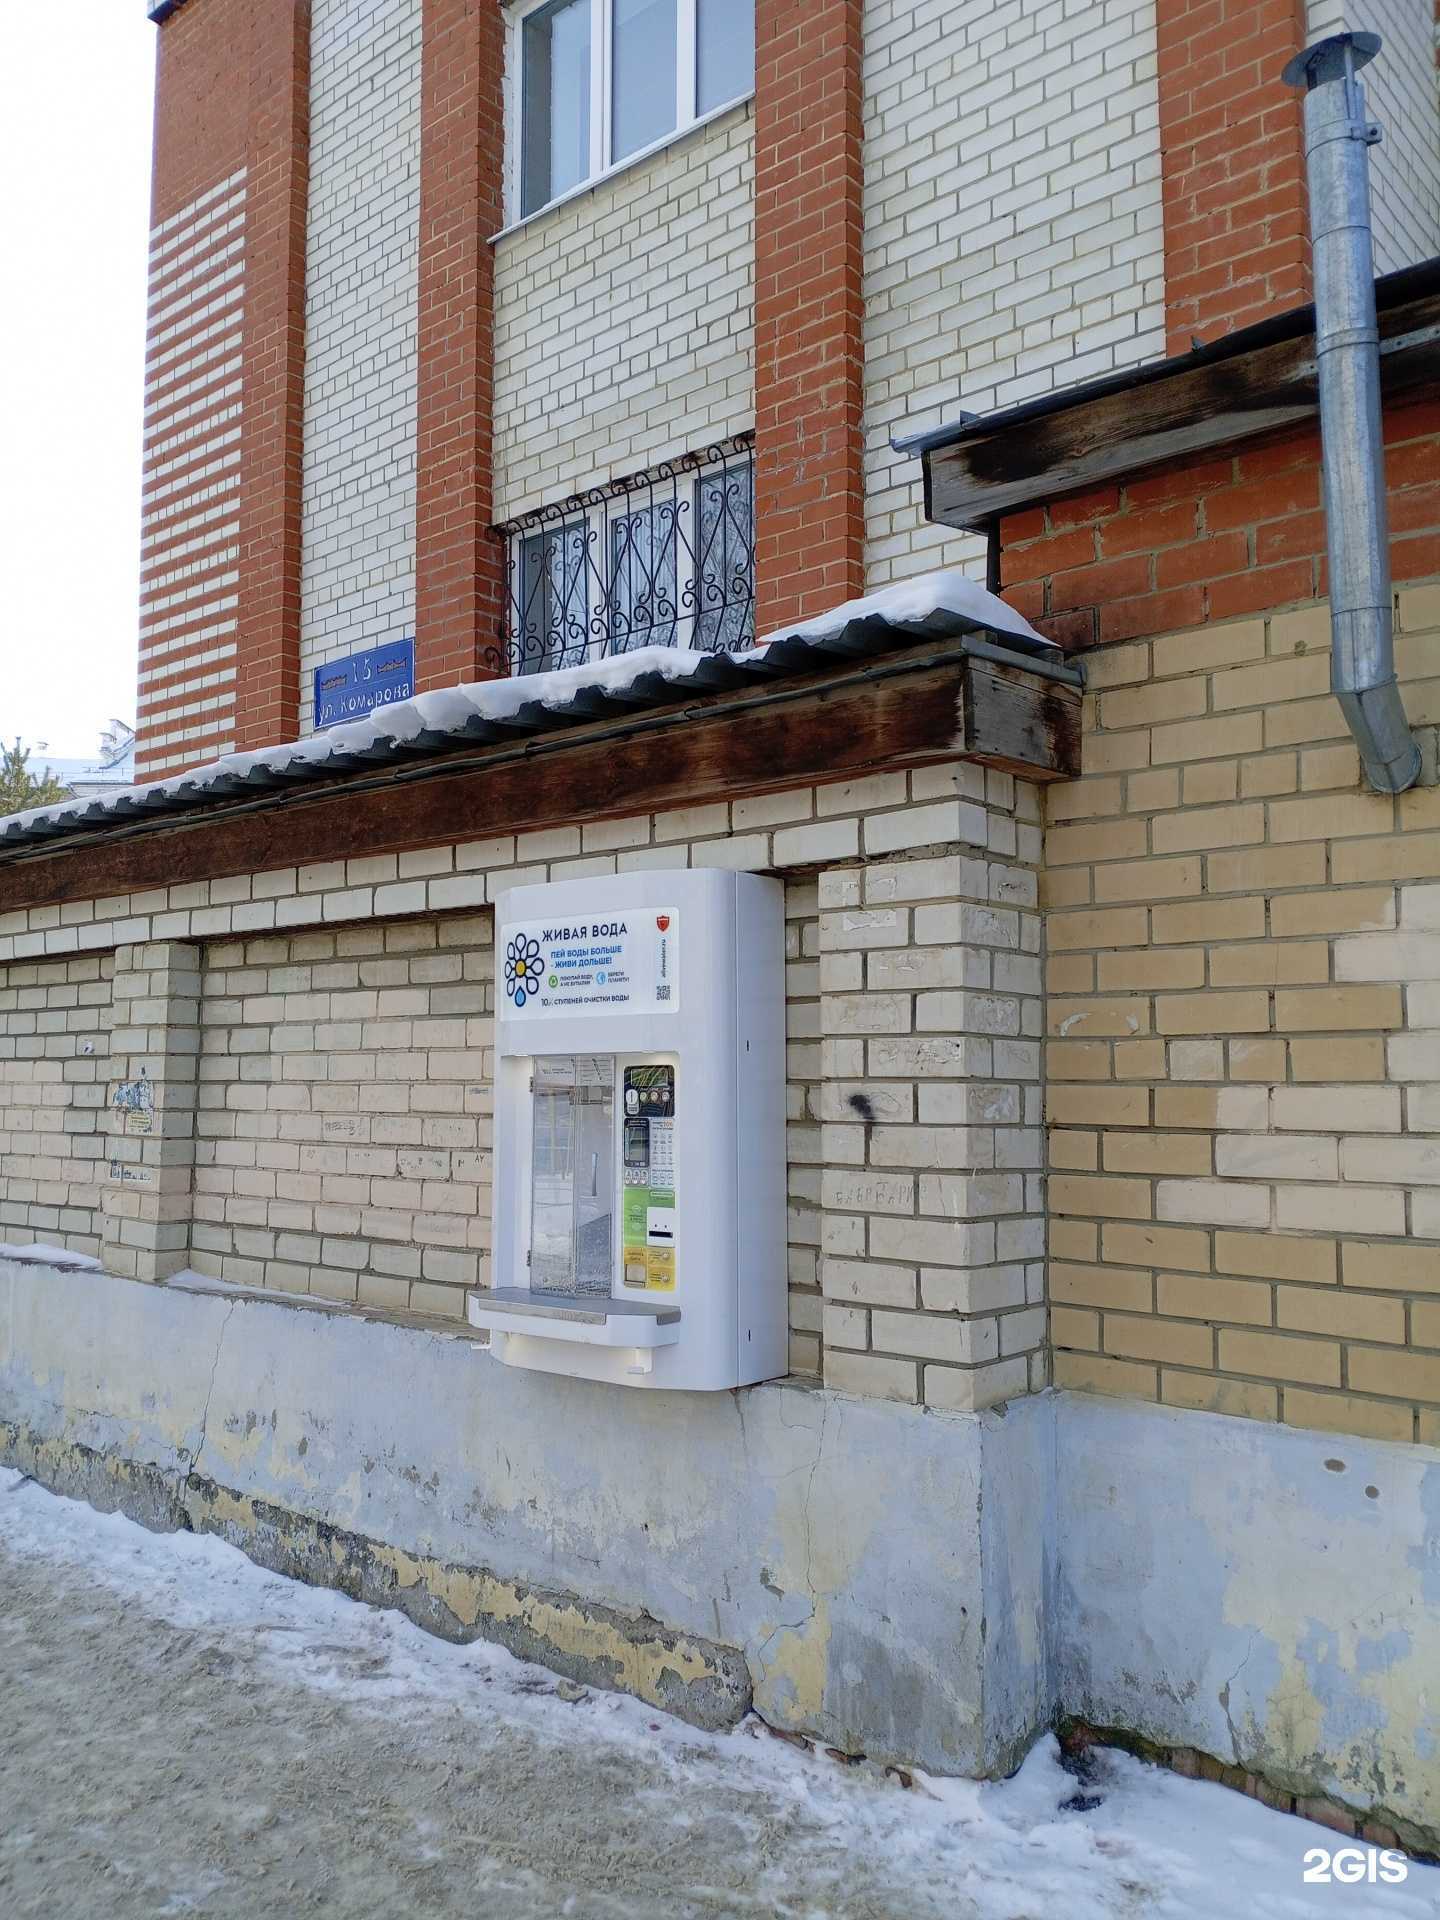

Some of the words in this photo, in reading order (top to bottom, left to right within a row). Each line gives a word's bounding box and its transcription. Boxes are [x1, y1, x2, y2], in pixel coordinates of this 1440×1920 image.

[352, 656, 372, 683] 15
[318, 703, 337, 725] ул.
[340, 682, 410, 713] Комарова
[542, 926, 587, 942] ЖИВАЯ
[592, 923, 628, 938] ВОДА
[551, 949, 566, 959] ПЕЙ
[567, 948, 589, 957] ВОДЫ
[590, 945, 622, 956] БОЛЬШЕ
[555, 960, 577, 968] ЖИВИ
[578, 957, 613, 967] ДОЛЬШЕ!
[611, 994, 629, 1002] ВОДЫ
